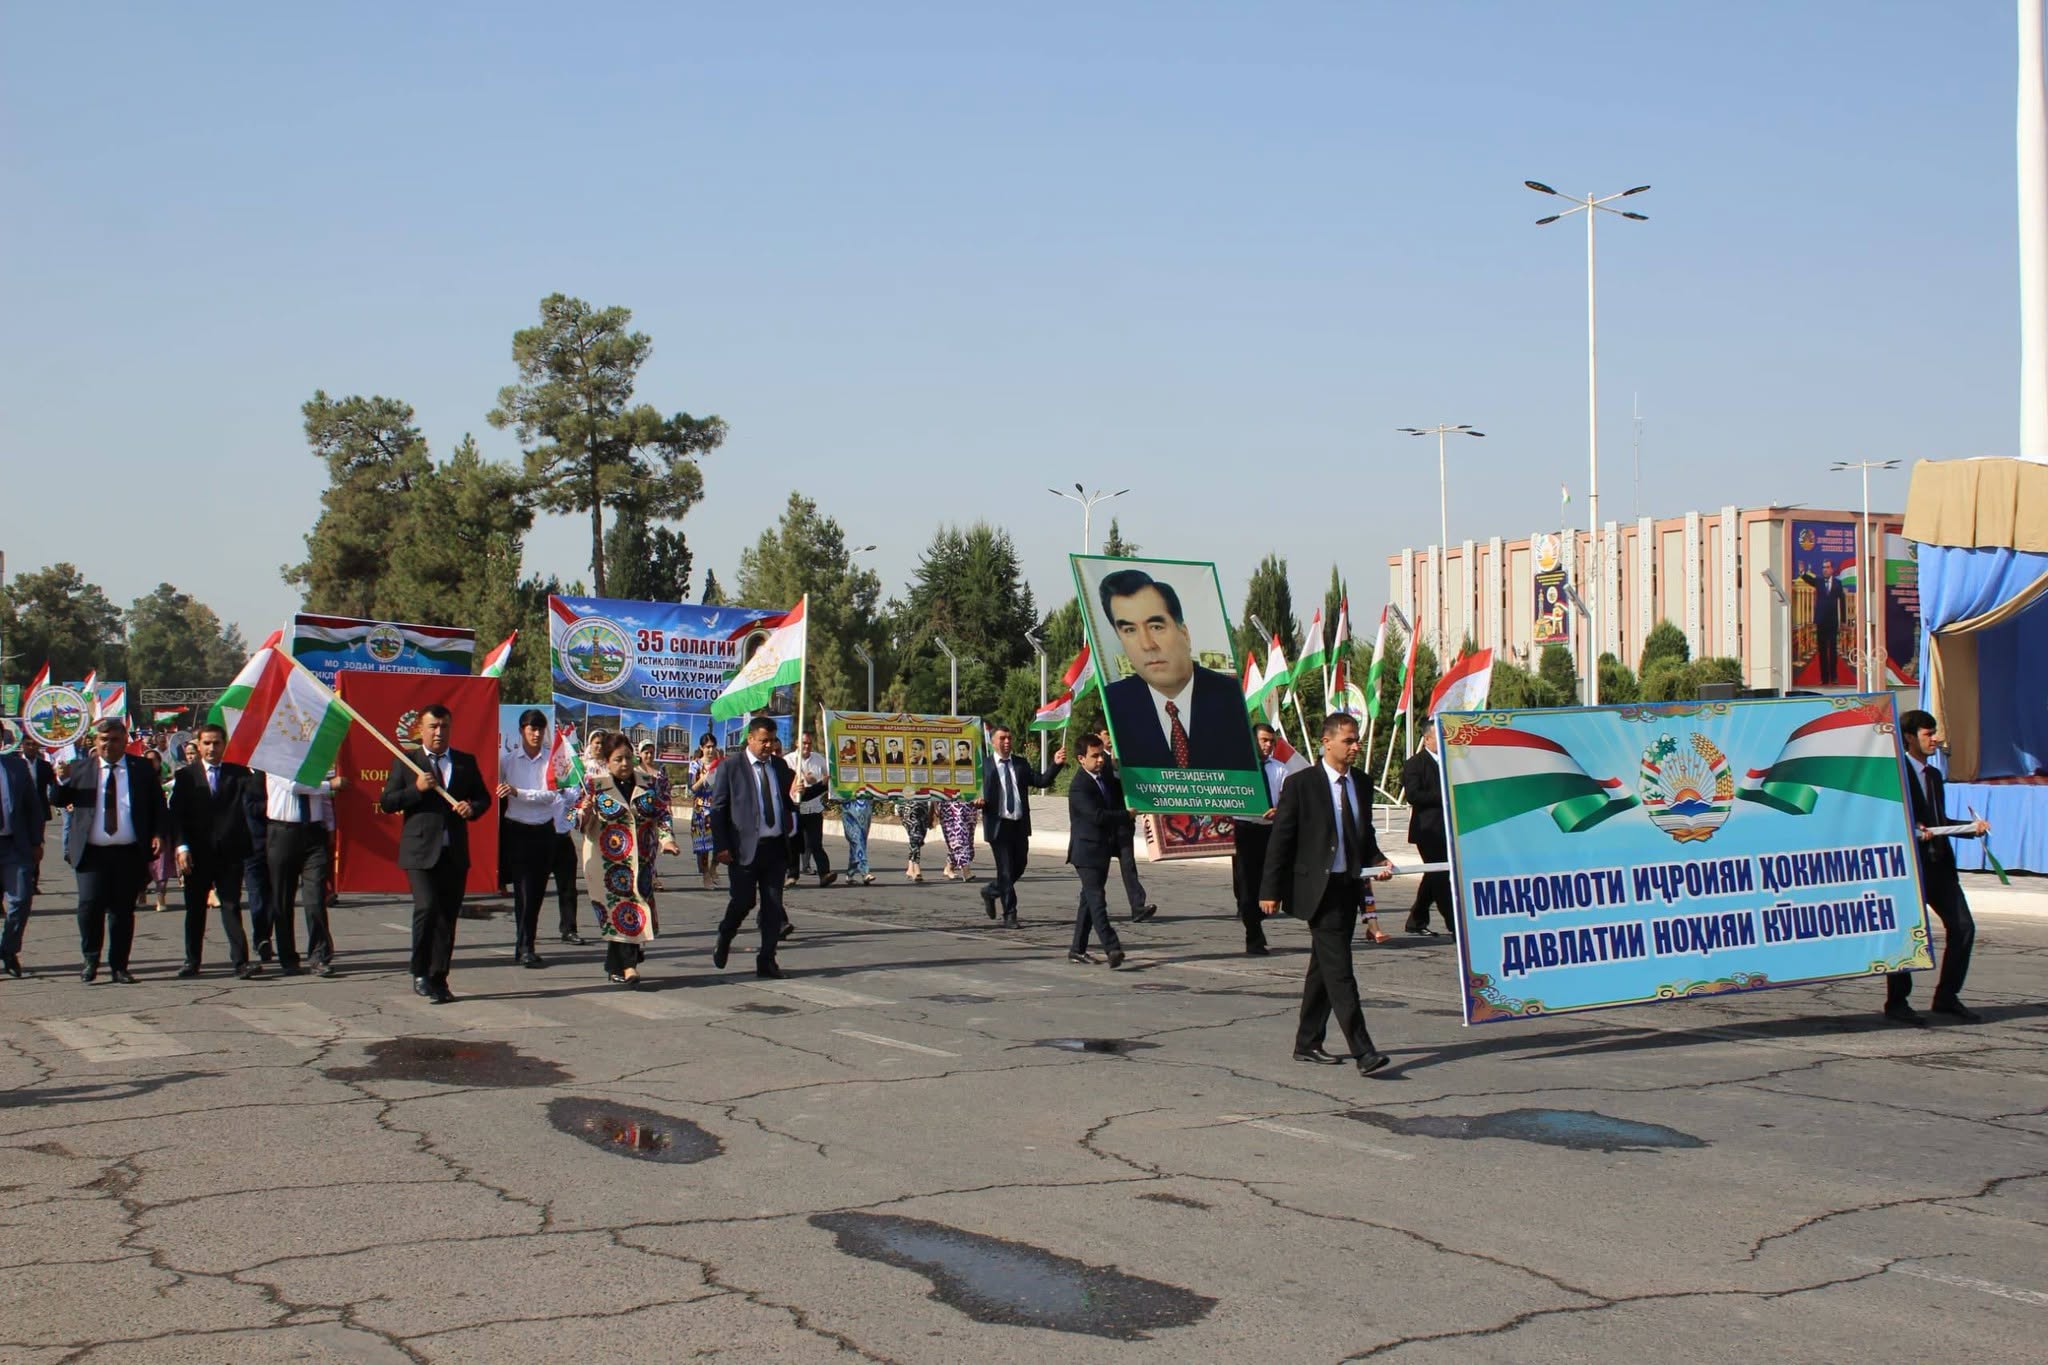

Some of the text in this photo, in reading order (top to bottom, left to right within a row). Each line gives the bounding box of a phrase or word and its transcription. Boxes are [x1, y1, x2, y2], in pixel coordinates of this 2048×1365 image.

[637, 629, 664, 653] 35
[670, 637, 736, 657] СОЛАГИИ
[324, 659, 339, 668] МО
[651, 670, 722, 684] ҶУМҲУРИИ
[641, 685, 722, 701] ТОҶИКИСТО
[1161, 770, 1225, 781] ПРЕЗИДЕНТИ
[1136, 783, 1255, 796] ҶУМҲУРИИ ТОҶИКИСТОН
[1153, 796, 1246, 809] ЭМОМАЛӢ РАҲМОН
[1472, 845, 1907, 918] МАҚОМОТИ ИҶРОИЯИ ҲОКИМИЯТИ
[1502, 893, 1896, 977] ДАВЛАТИИ НОҲИЯИ КӮШОНИЁН
